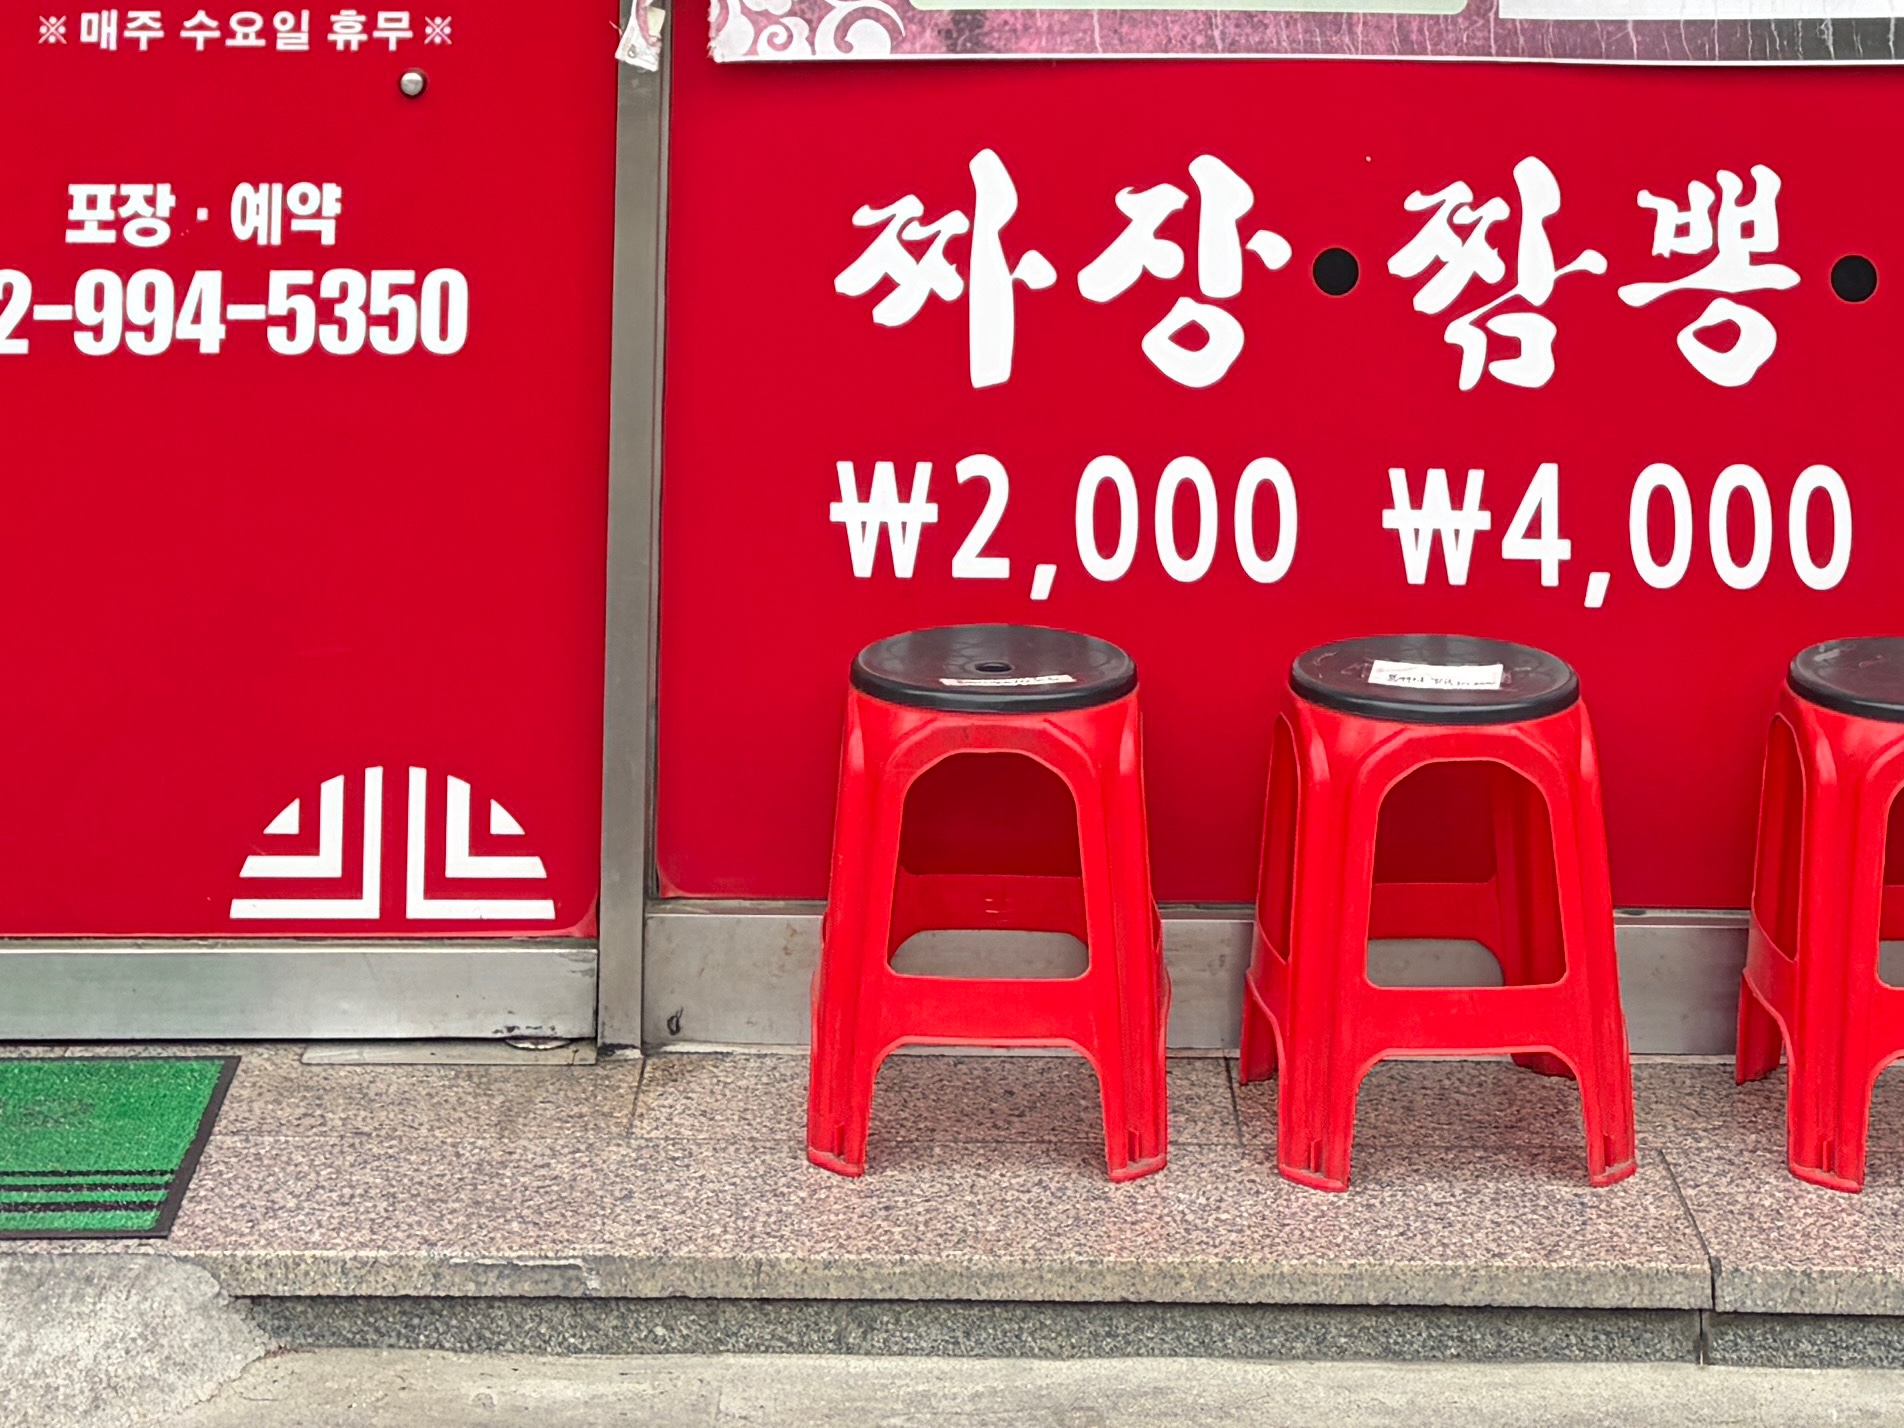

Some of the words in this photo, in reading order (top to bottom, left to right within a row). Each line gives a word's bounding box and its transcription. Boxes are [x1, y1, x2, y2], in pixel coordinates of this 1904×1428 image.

[79, 10, 165, 50] 매주
[179, 9, 311, 51] 수요일
[64, 182, 177, 247] 포장
[229, 181, 342, 247] 예약
[835, 149, 1293, 390] 짜장
[1387, 155, 1806, 392] 짬뽕
[830, 454, 1299, 600] ₩2,000
[1382, 462, 1855, 608] ₩4,000
